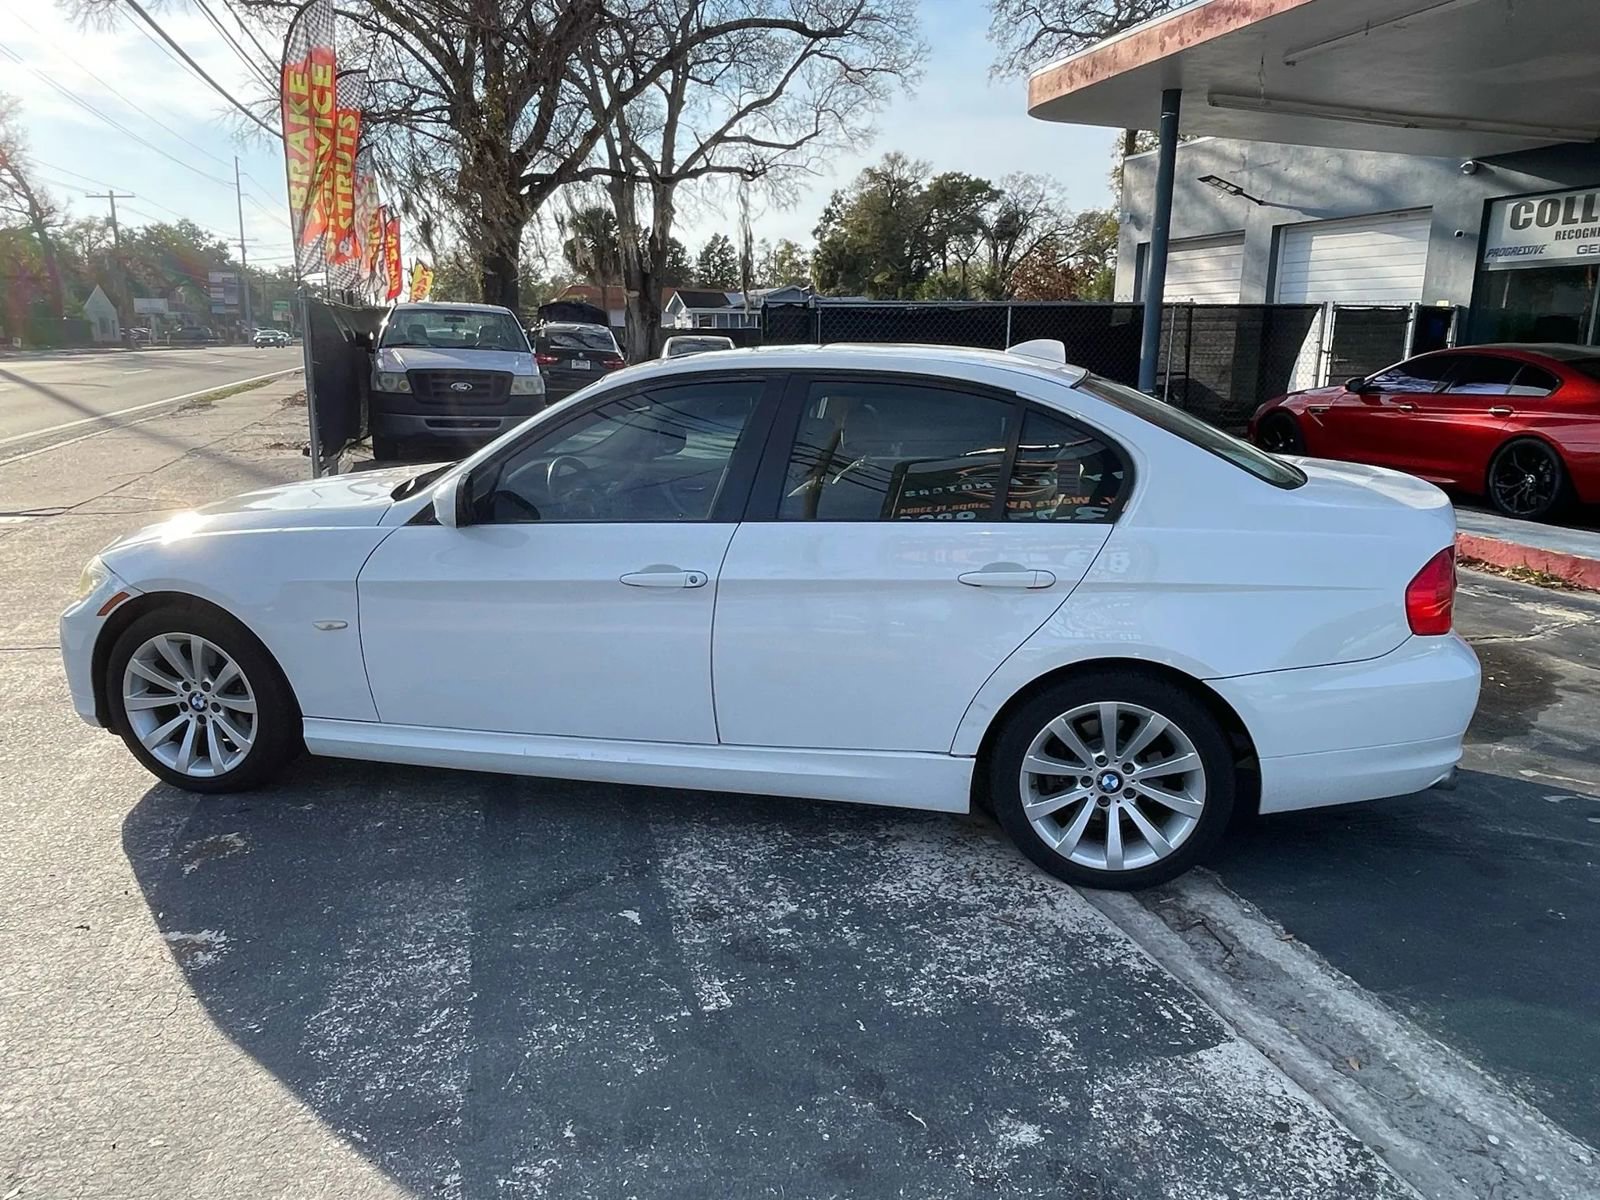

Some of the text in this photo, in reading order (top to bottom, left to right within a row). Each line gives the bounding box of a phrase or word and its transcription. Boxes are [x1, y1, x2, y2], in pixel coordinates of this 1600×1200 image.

[288, 71, 311, 209] BRAKE
[335, 113, 357, 230] STRUTS
[1510, 193, 1599, 230] COLL
[1486, 244, 1547, 258] PROGRESSIVE
